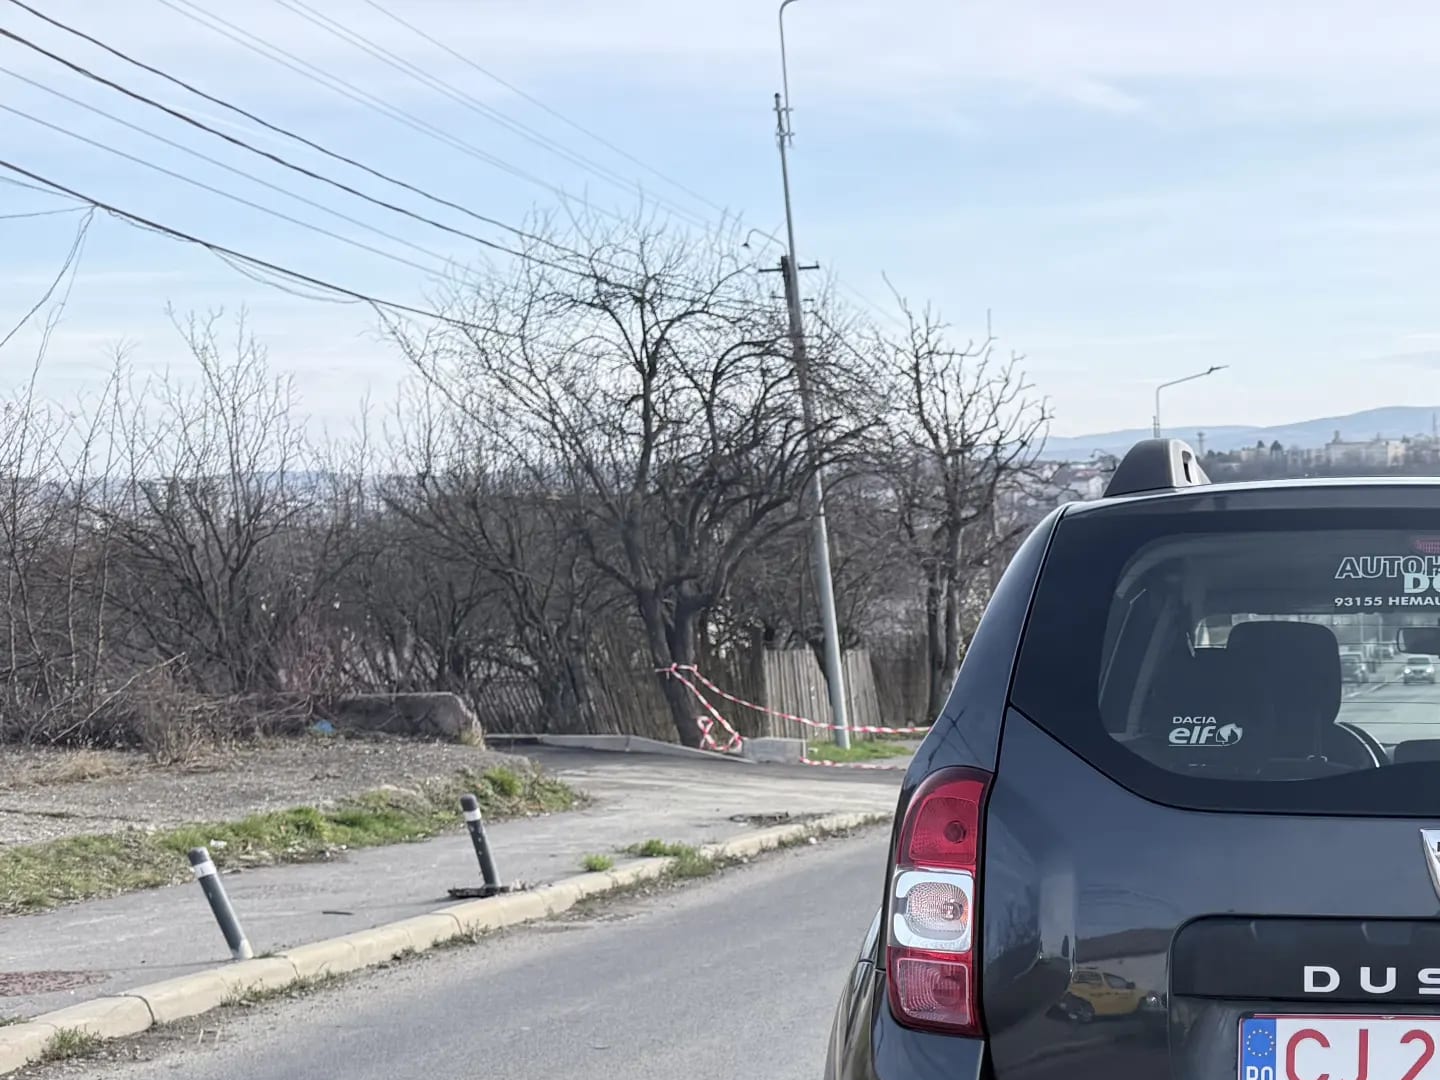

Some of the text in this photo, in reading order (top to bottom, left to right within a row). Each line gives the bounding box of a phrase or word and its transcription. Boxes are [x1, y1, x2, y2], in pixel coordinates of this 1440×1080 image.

[1334, 597, 1382, 607] 93155
[1172, 716, 1217, 724] DACIA
[1168, 725, 1217, 744] elf
